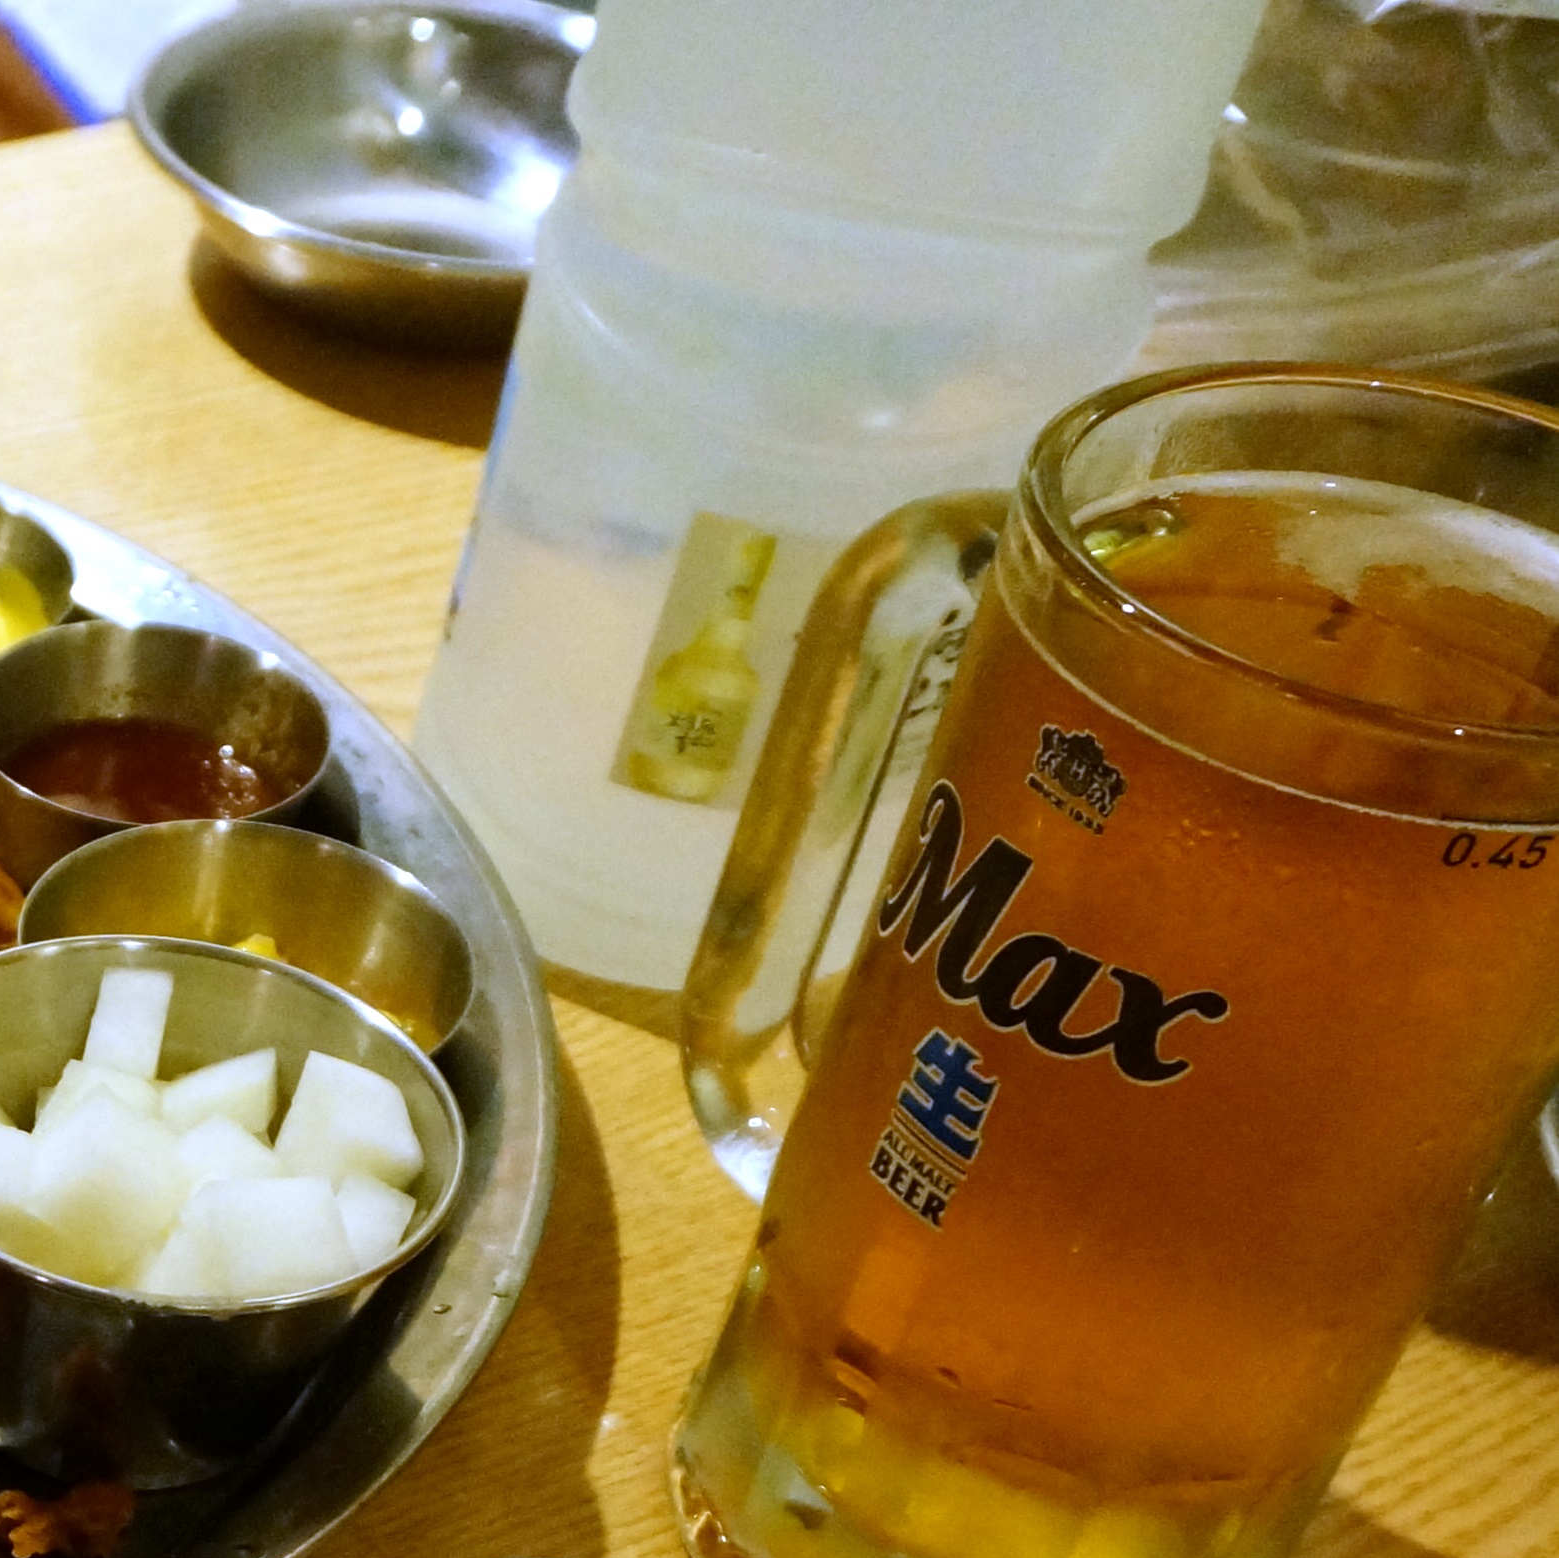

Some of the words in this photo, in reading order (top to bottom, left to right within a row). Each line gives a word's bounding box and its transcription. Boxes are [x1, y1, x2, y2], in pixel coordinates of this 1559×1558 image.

[1441, 832, 1557, 870] 0.45
[878, 778, 1230, 1087] Max
[896, 1026, 1001, 1165] 生
[871, 1146, 946, 1227] BEER
[882, 1128, 914, 1163] ALL
[908, 1154, 955, 1194] MALT
